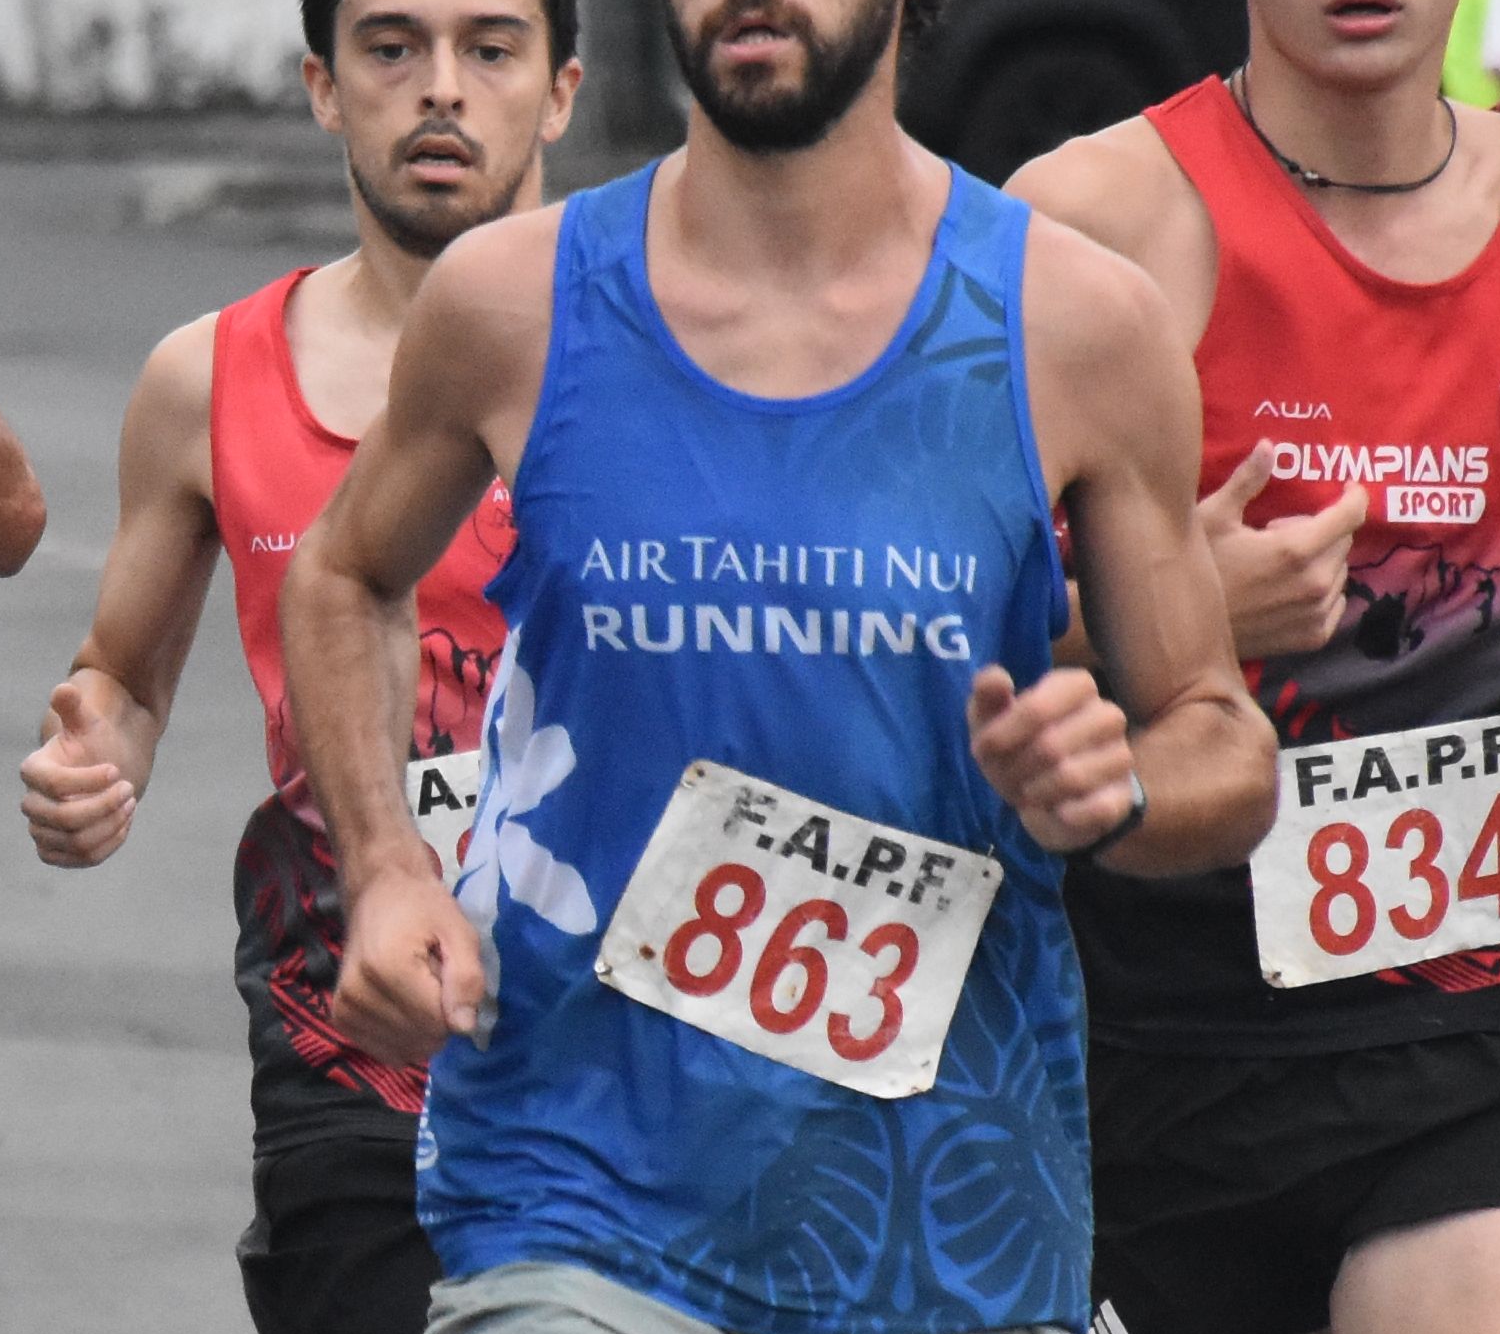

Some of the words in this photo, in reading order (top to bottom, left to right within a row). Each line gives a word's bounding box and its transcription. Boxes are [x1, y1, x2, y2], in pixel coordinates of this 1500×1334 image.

[1254, 400, 1333, 420] AWA
[1271, 442, 1490, 483] OLYMPIANS
[1399, 490, 1475, 517] SPORT
[251, 533, 296, 554] AW
[581, 538, 677, 585] AIR
[680, 536, 864, 588] TAHITI
[886, 543, 977, 594] NUI
[582, 603, 972, 661] RUNNING
[662, 862, 920, 1062] 863
